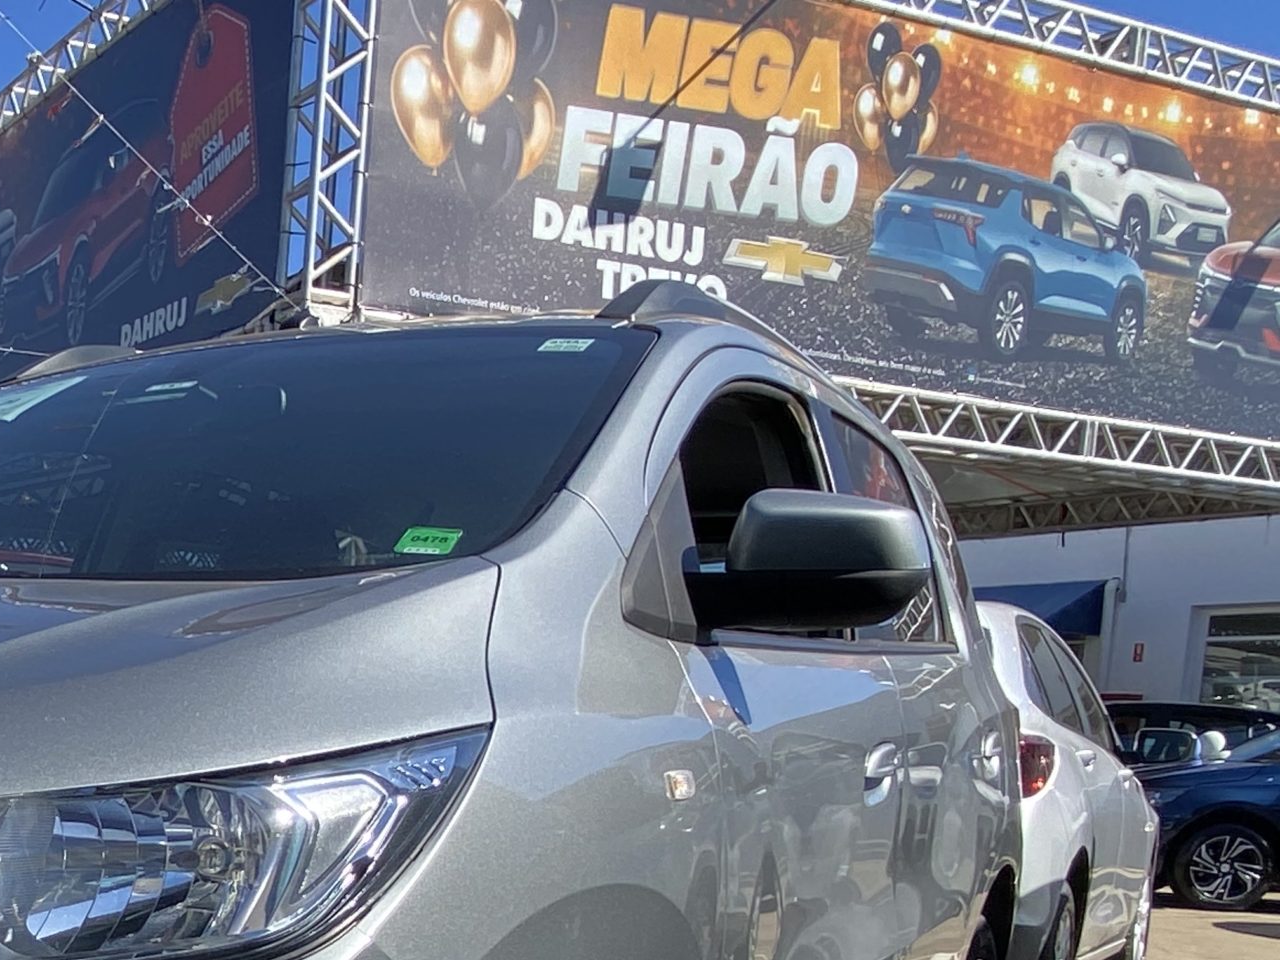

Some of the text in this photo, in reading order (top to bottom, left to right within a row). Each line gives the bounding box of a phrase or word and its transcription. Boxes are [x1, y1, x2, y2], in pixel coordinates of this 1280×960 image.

[596, 3, 842, 130] MEGA
[201, 129, 224, 166] ESSA
[557, 105, 858, 227] FEIRÃO
[532, 197, 706, 266] DAHRUJ
[120, 296, 187, 347] DAHRUJ
